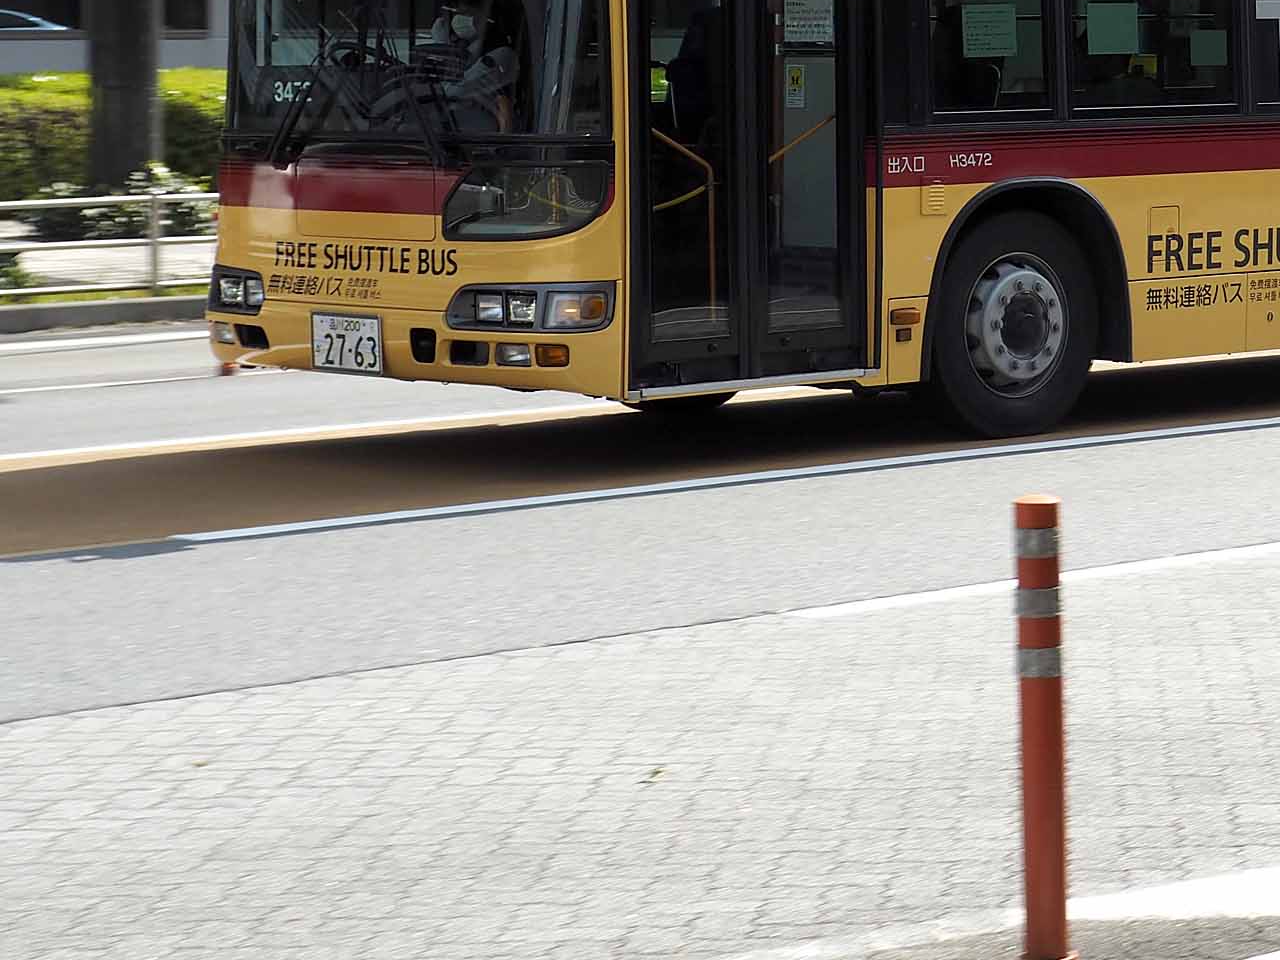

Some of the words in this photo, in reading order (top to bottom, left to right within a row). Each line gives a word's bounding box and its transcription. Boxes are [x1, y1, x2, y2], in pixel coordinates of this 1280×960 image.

[888, 155, 925, 174] 出入口
[949, 152, 993, 168] H3472
[274, 241, 317, 269] FREE
[323, 243, 411, 274] SHUTTLE
[416, 247, 458, 277] BUS
[1147, 229, 1223, 274] FREE
[267, 274, 344, 297] 無料連絡バス
[1146, 282, 1244, 310] 無料連絡バス
